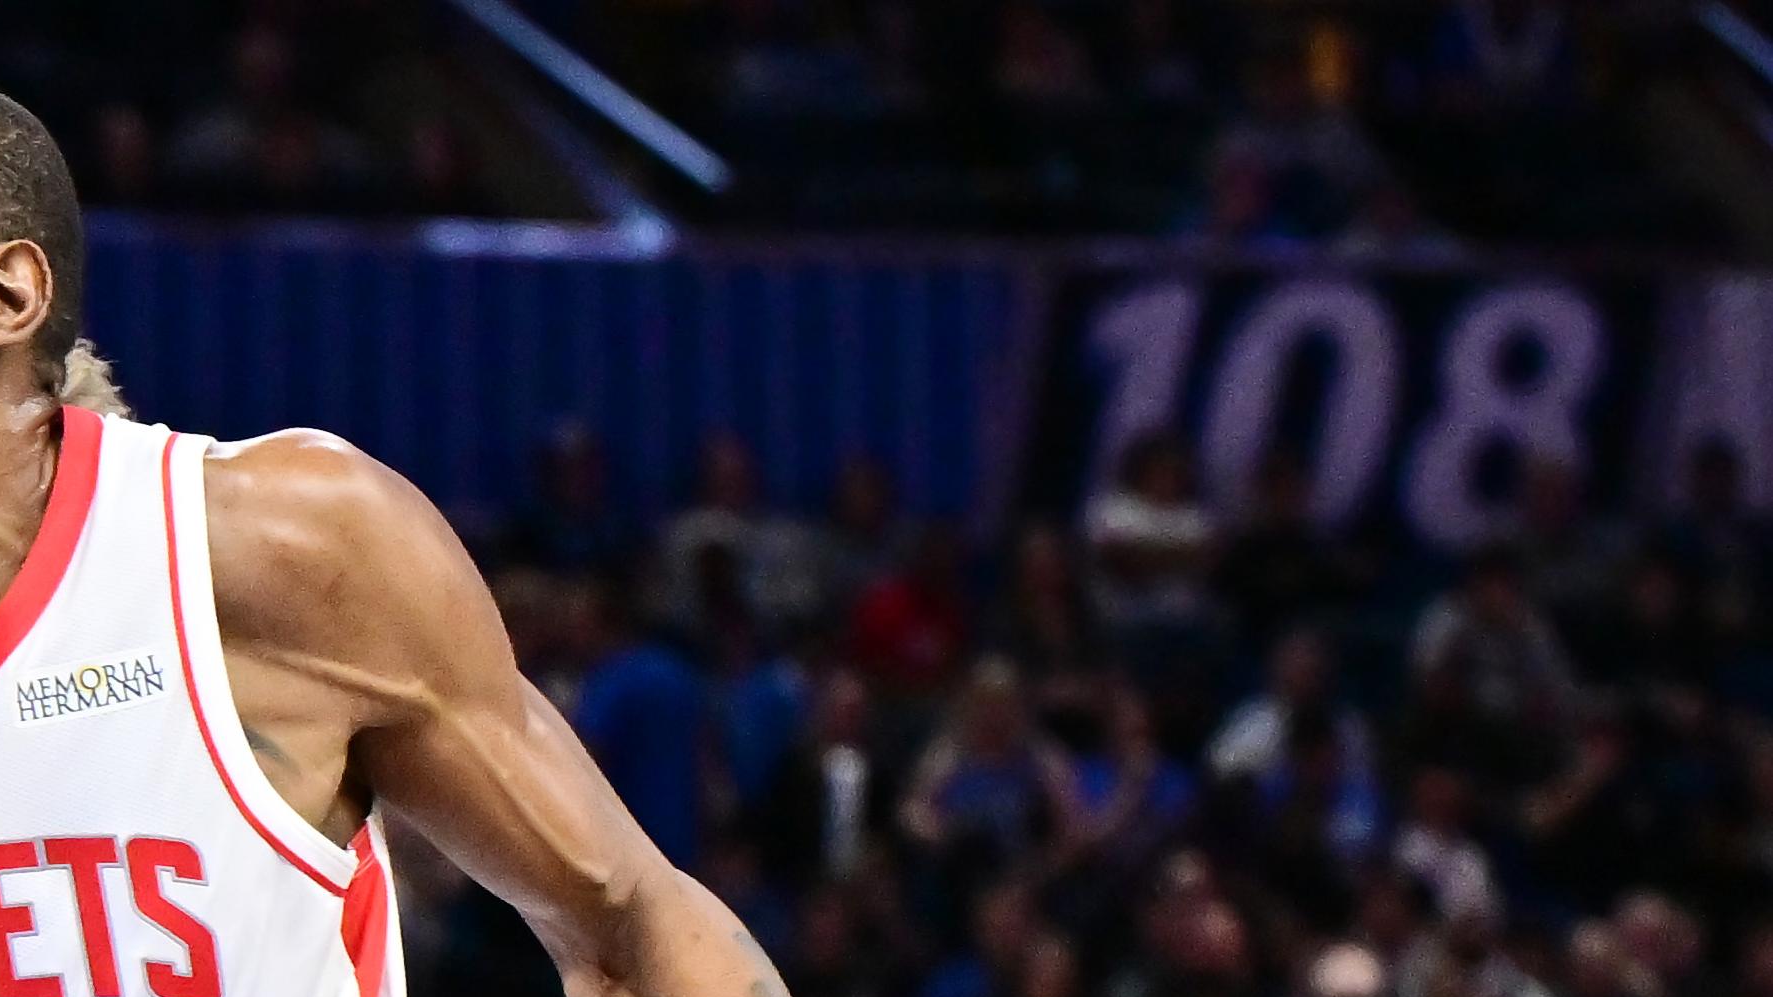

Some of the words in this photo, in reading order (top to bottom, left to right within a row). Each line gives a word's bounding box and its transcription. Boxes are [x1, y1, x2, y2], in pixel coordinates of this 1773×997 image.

[1087, 280, 1605, 548] 108
[17, 655, 163, 702] MEMORIAL
[18, 673, 164, 721] HERMANN
